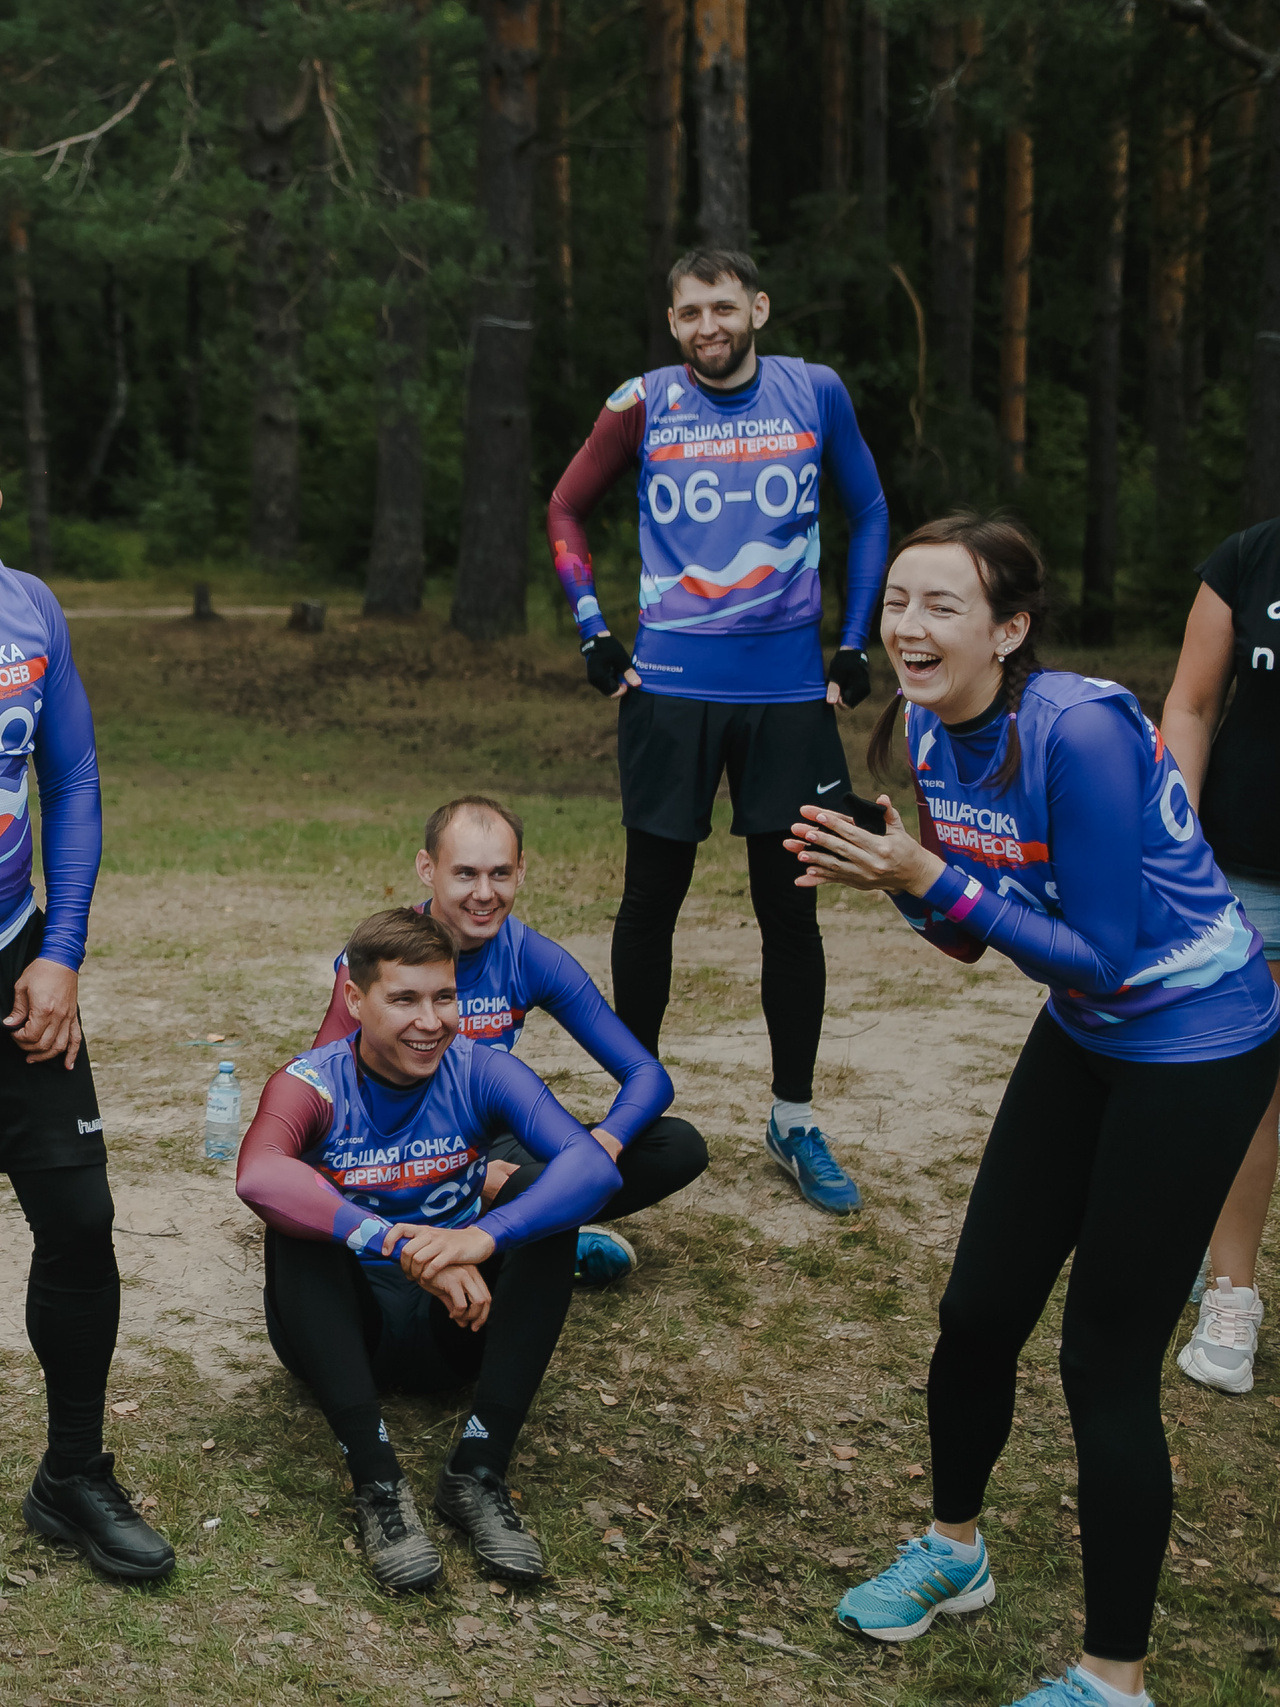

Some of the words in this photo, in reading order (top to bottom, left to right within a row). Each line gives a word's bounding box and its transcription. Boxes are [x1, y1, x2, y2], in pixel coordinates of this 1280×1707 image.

[648, 421, 734, 446] БОЛЬШАЯ
[736, 418, 796, 437] ГОНКА
[683, 439, 736, 459] ВРЕМЯ
[738, 435, 798, 453] ГЕРОЕВ
[647, 462, 818, 525] 06-02
[404, 1135, 467, 1160] ГОНКА
[344, 1165, 401, 1185] ВРЕМЯ
[404, 1153, 469, 1178] ГЕРОЕВ
